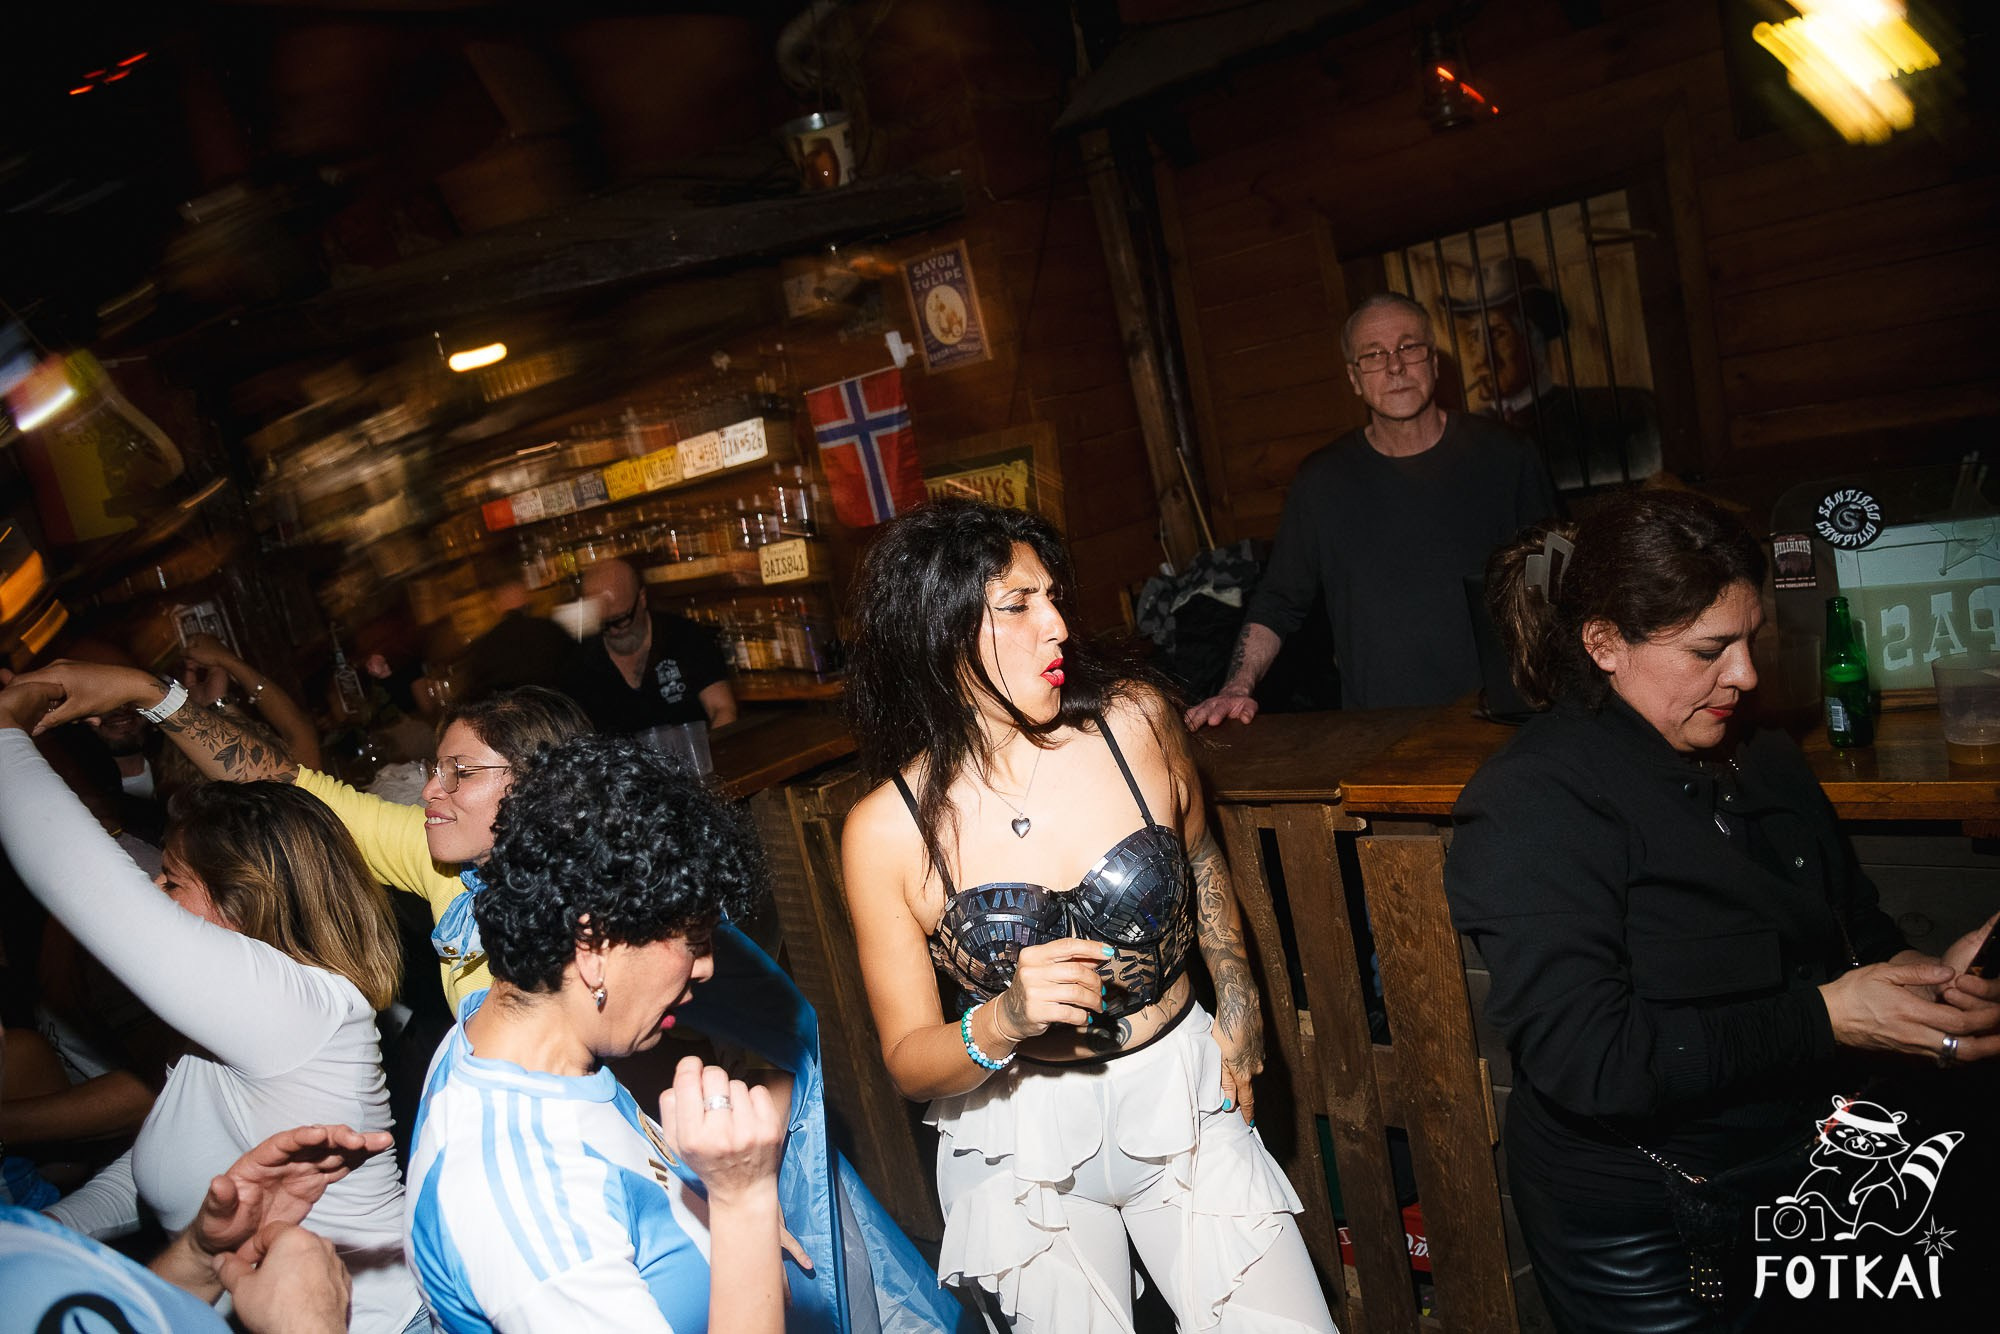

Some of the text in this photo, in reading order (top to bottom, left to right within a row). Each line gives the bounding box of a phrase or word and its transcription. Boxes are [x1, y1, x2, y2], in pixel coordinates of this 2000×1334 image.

[912, 255, 955, 279] SAVON
[912, 268, 962, 291] TULIPE
[1818, 489, 1881, 519] SANTIAGO
[1815, 521, 1877, 547] CAMPILLO
